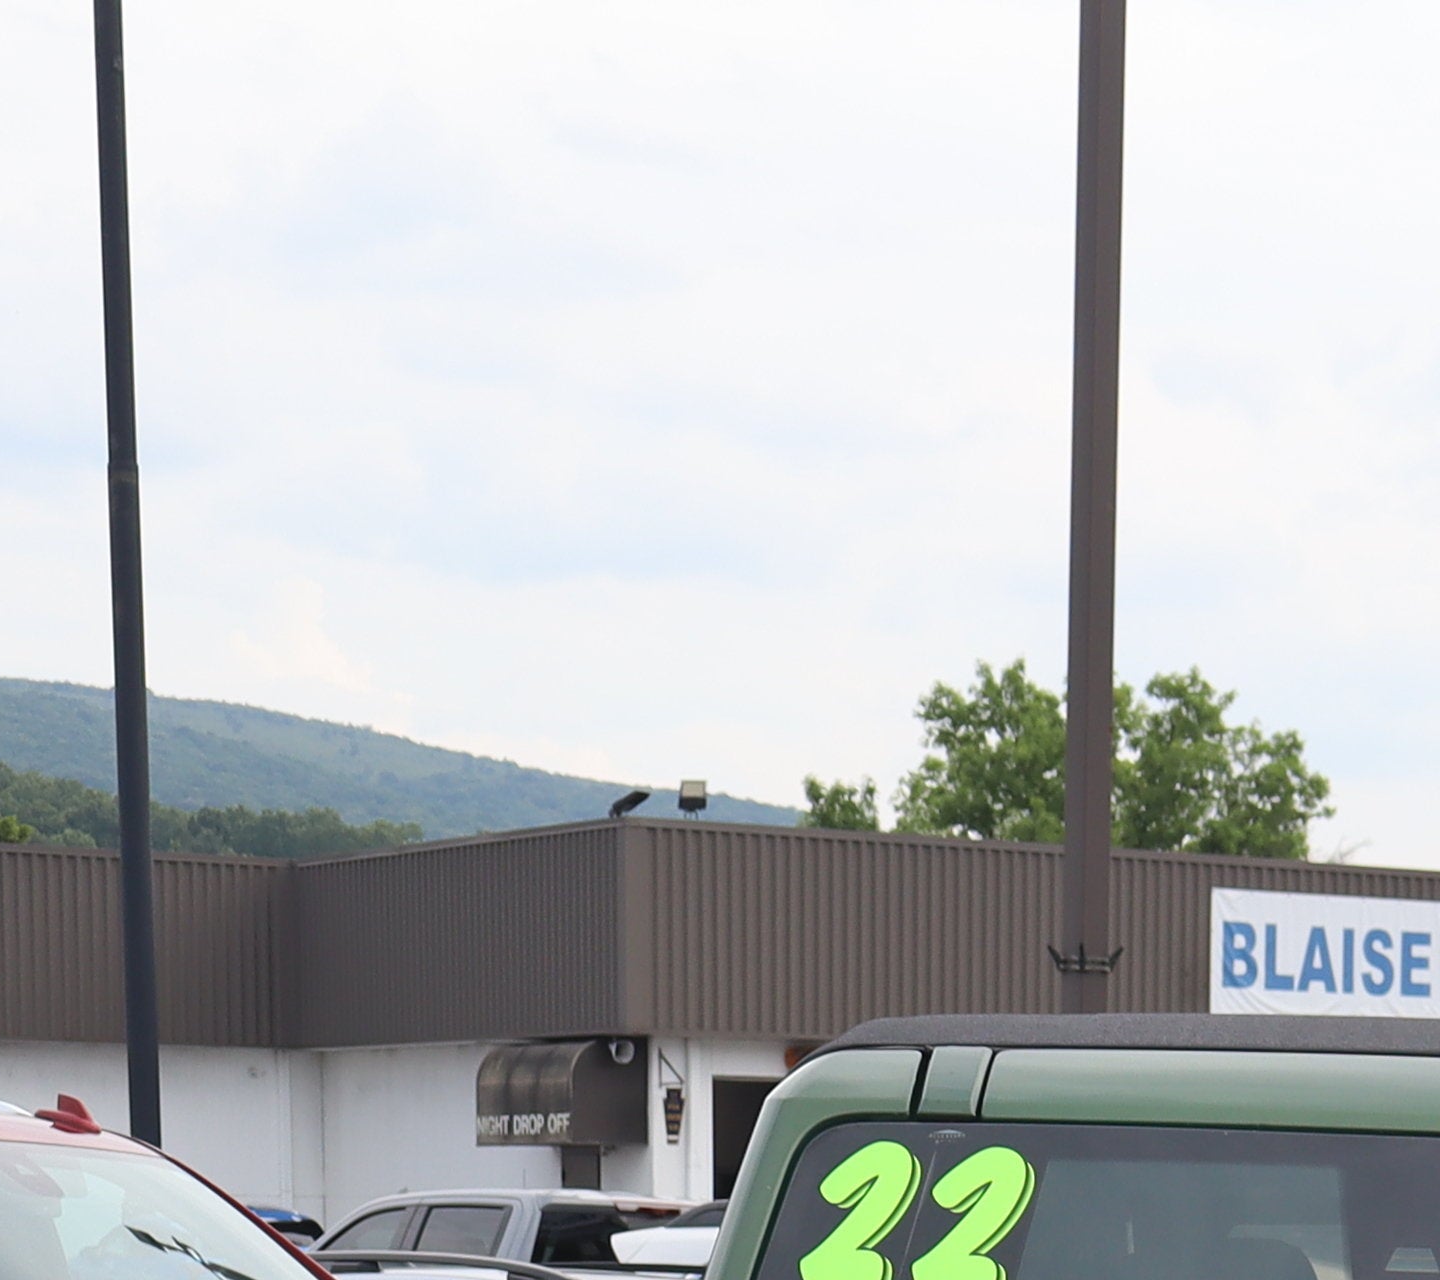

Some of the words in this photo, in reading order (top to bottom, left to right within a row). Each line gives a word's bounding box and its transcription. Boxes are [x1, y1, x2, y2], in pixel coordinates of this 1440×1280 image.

[1221, 919, 1432, 998] BLAISE
[477, 1115, 510, 1136] NIGHT
[513, 1113, 545, 1135] DROP
[547, 1112, 571, 1134] OFF
